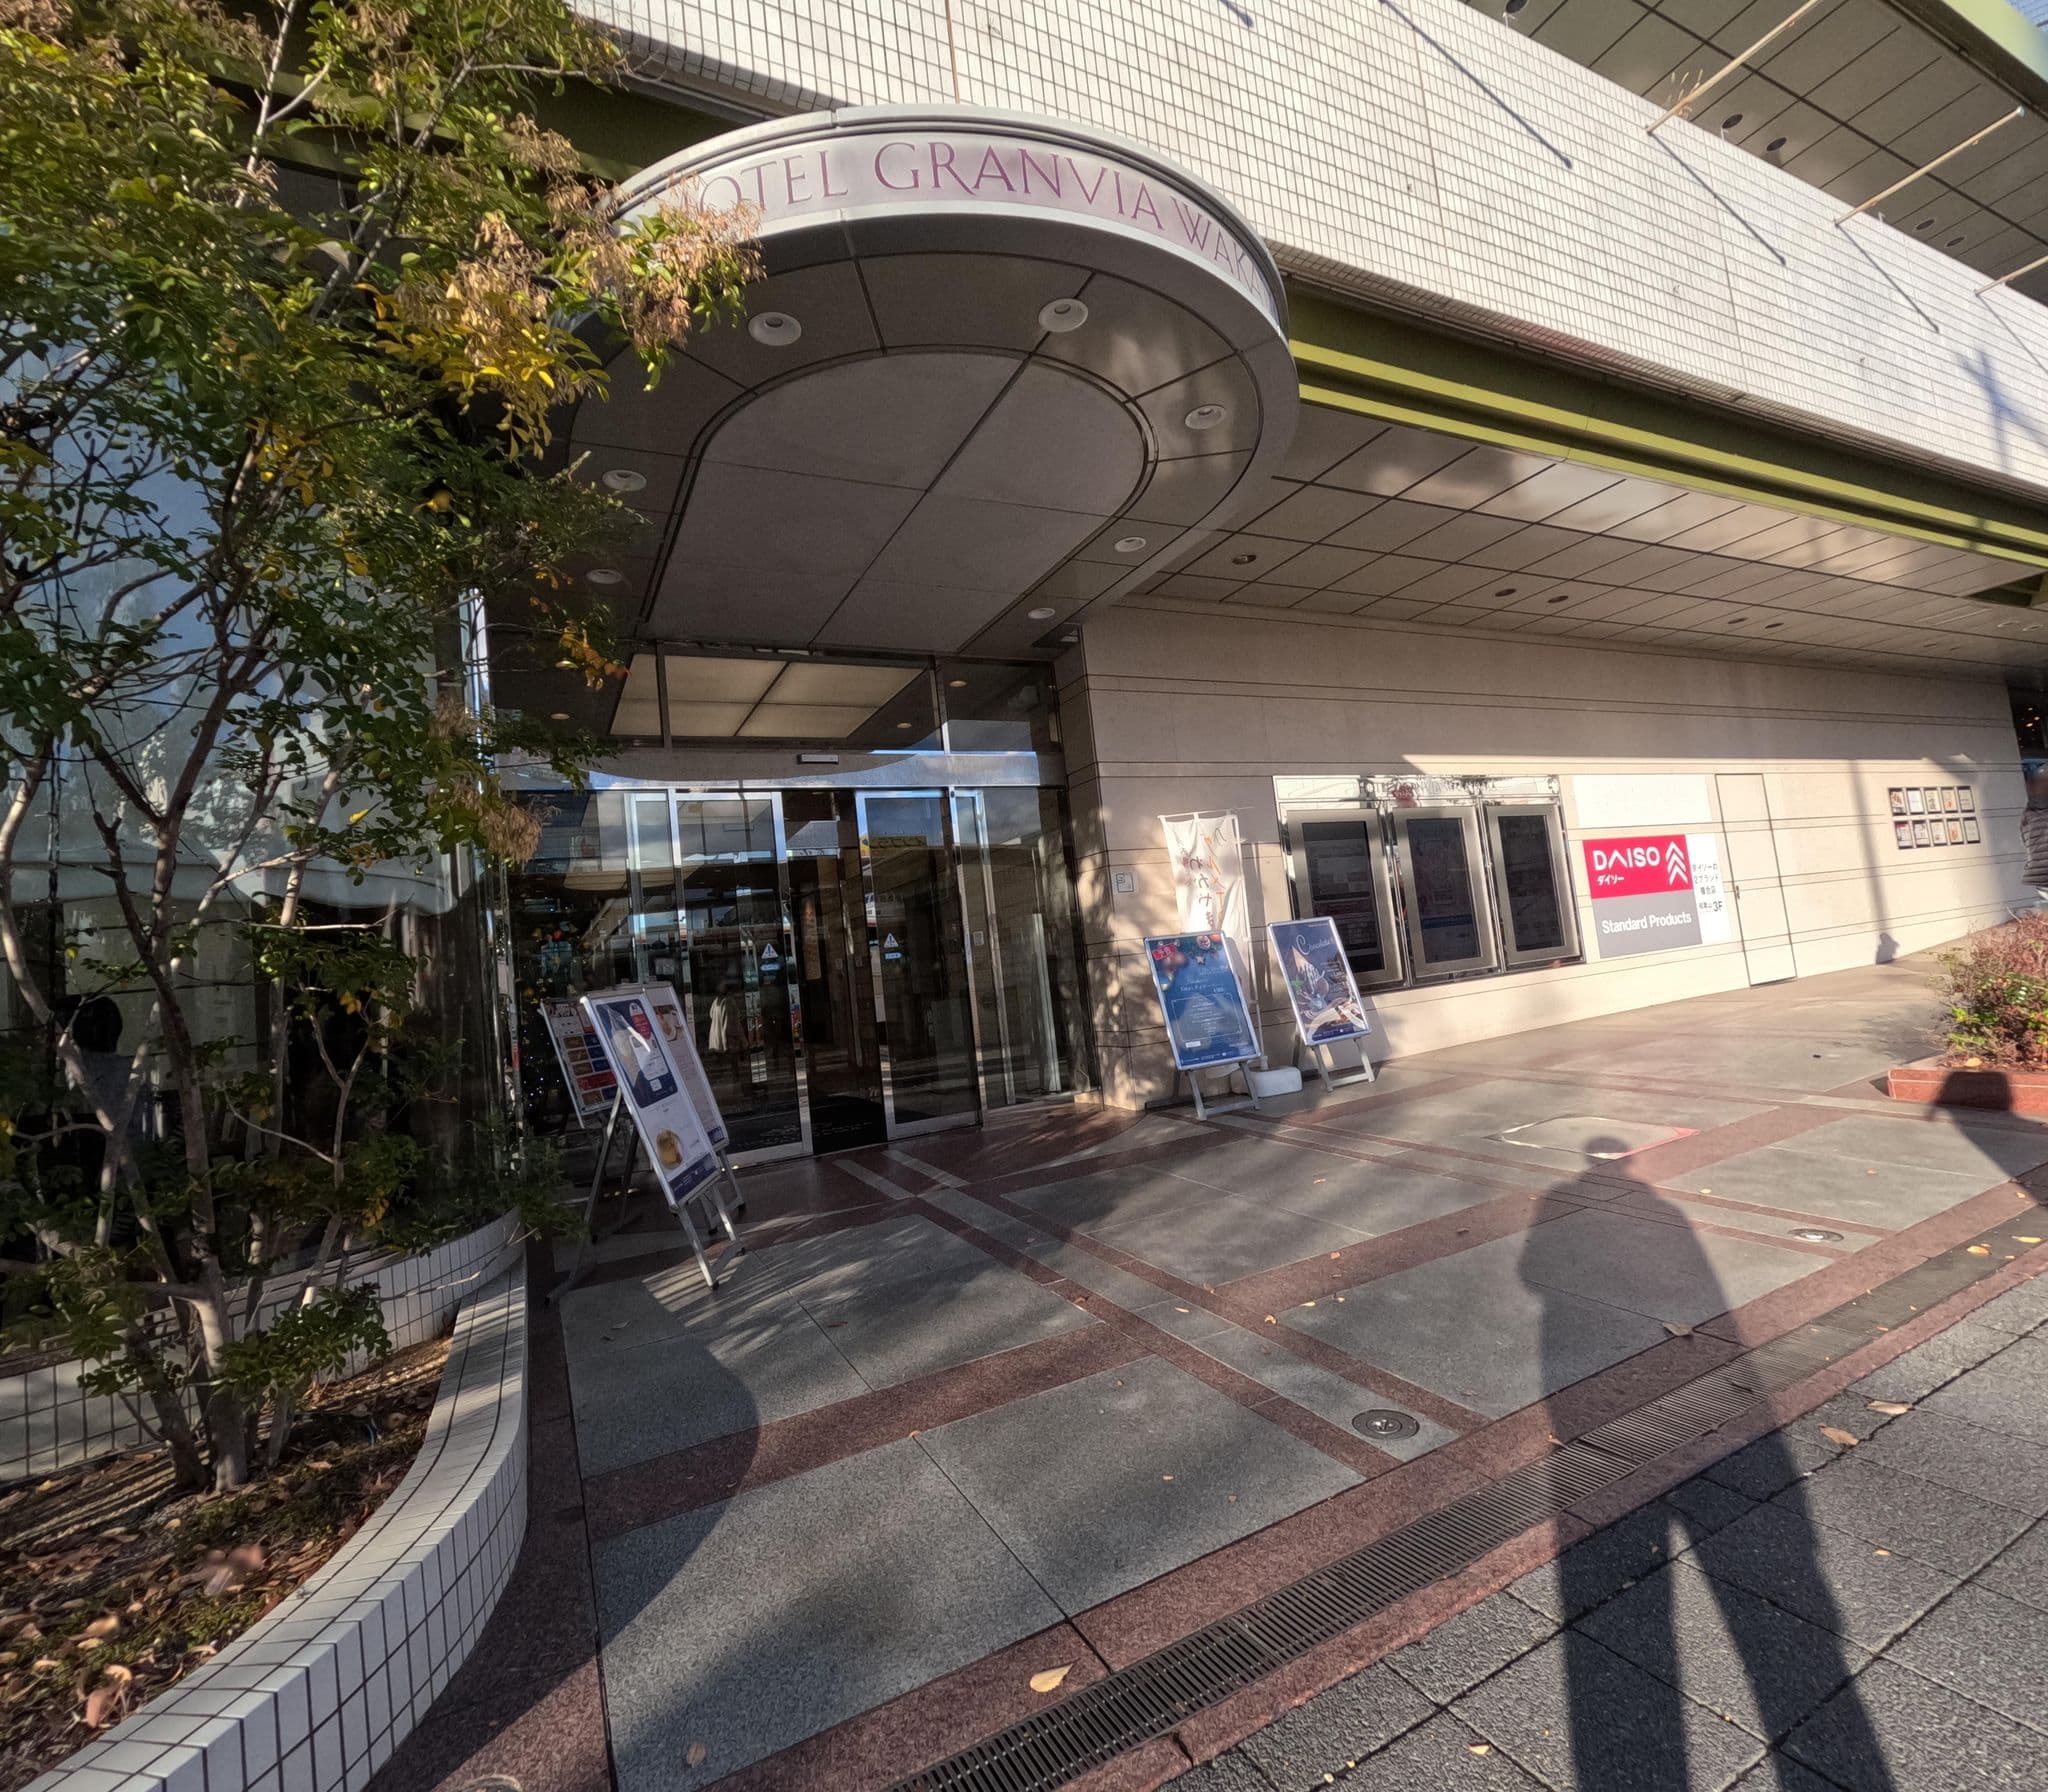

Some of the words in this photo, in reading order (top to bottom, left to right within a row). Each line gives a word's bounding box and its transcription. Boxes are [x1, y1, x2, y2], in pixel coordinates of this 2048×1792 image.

[681, 150, 849, 216] OTEL
[874, 141, 1165, 231] GRANVIA
[1592, 846, 1661, 872] DAISO
[1597, 874, 1625, 887] ダイソー
[1602, 915, 1648, 934] Standard
[1649, 912, 1692, 928] Products
